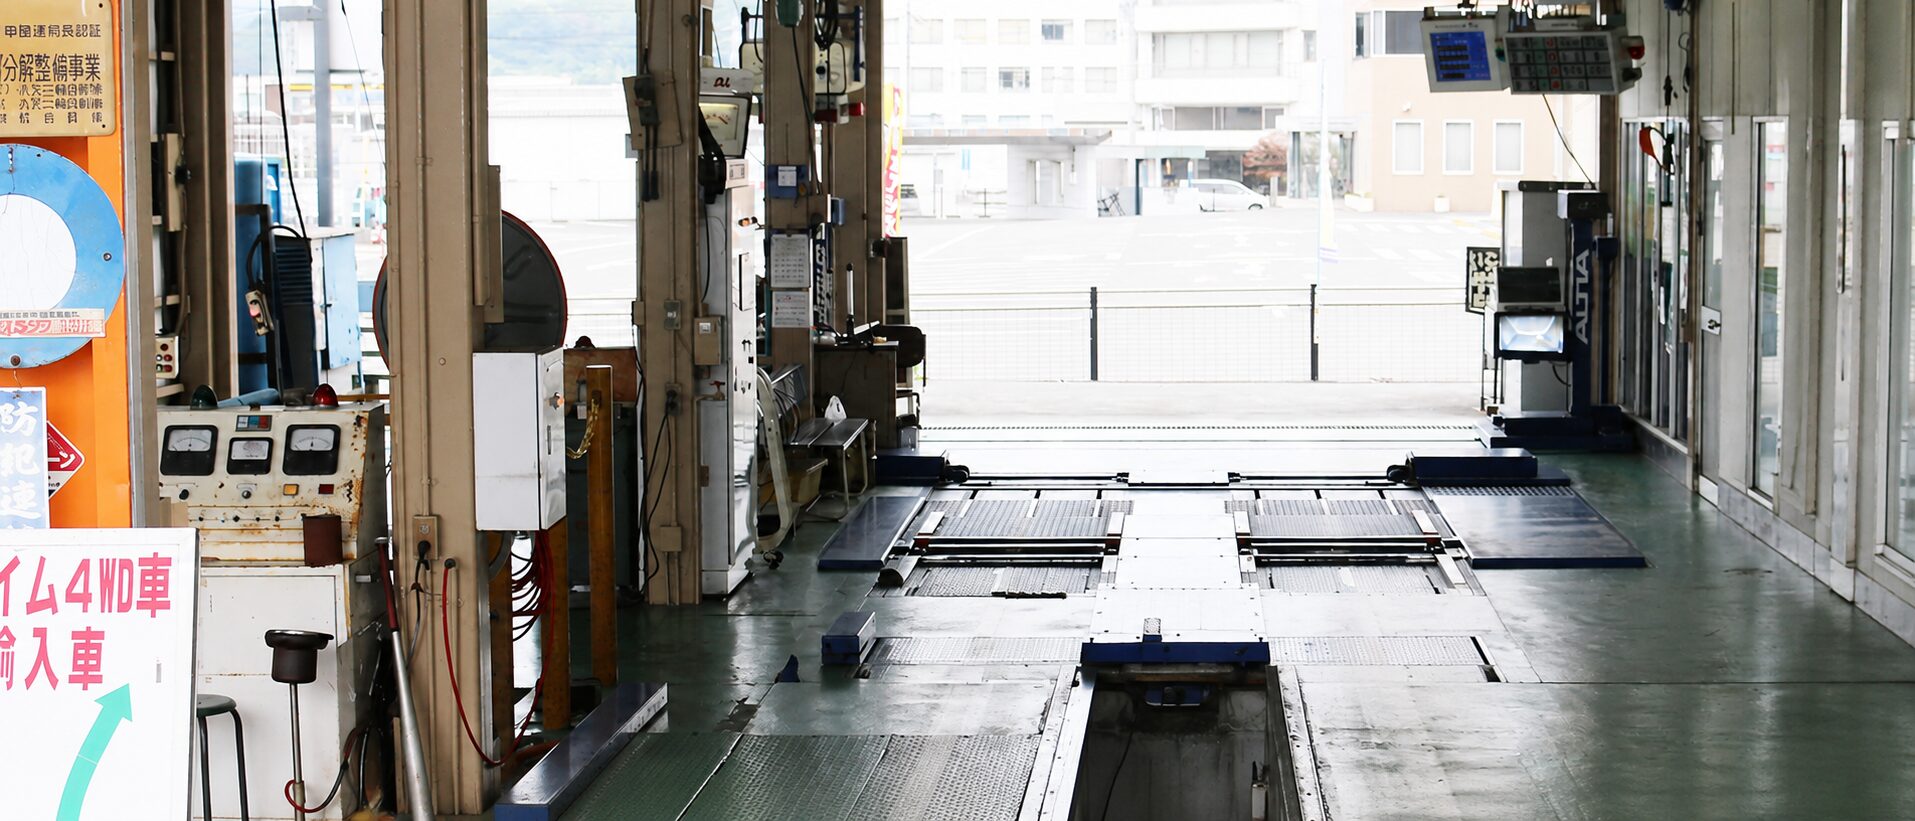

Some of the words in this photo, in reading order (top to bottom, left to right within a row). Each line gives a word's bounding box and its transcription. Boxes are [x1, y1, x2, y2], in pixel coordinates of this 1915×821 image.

[0, 53, 101, 83] 分解整備事業
[1575, 249, 1590, 345] ALTIA
[0, 401, 41, 529] 防犯連
